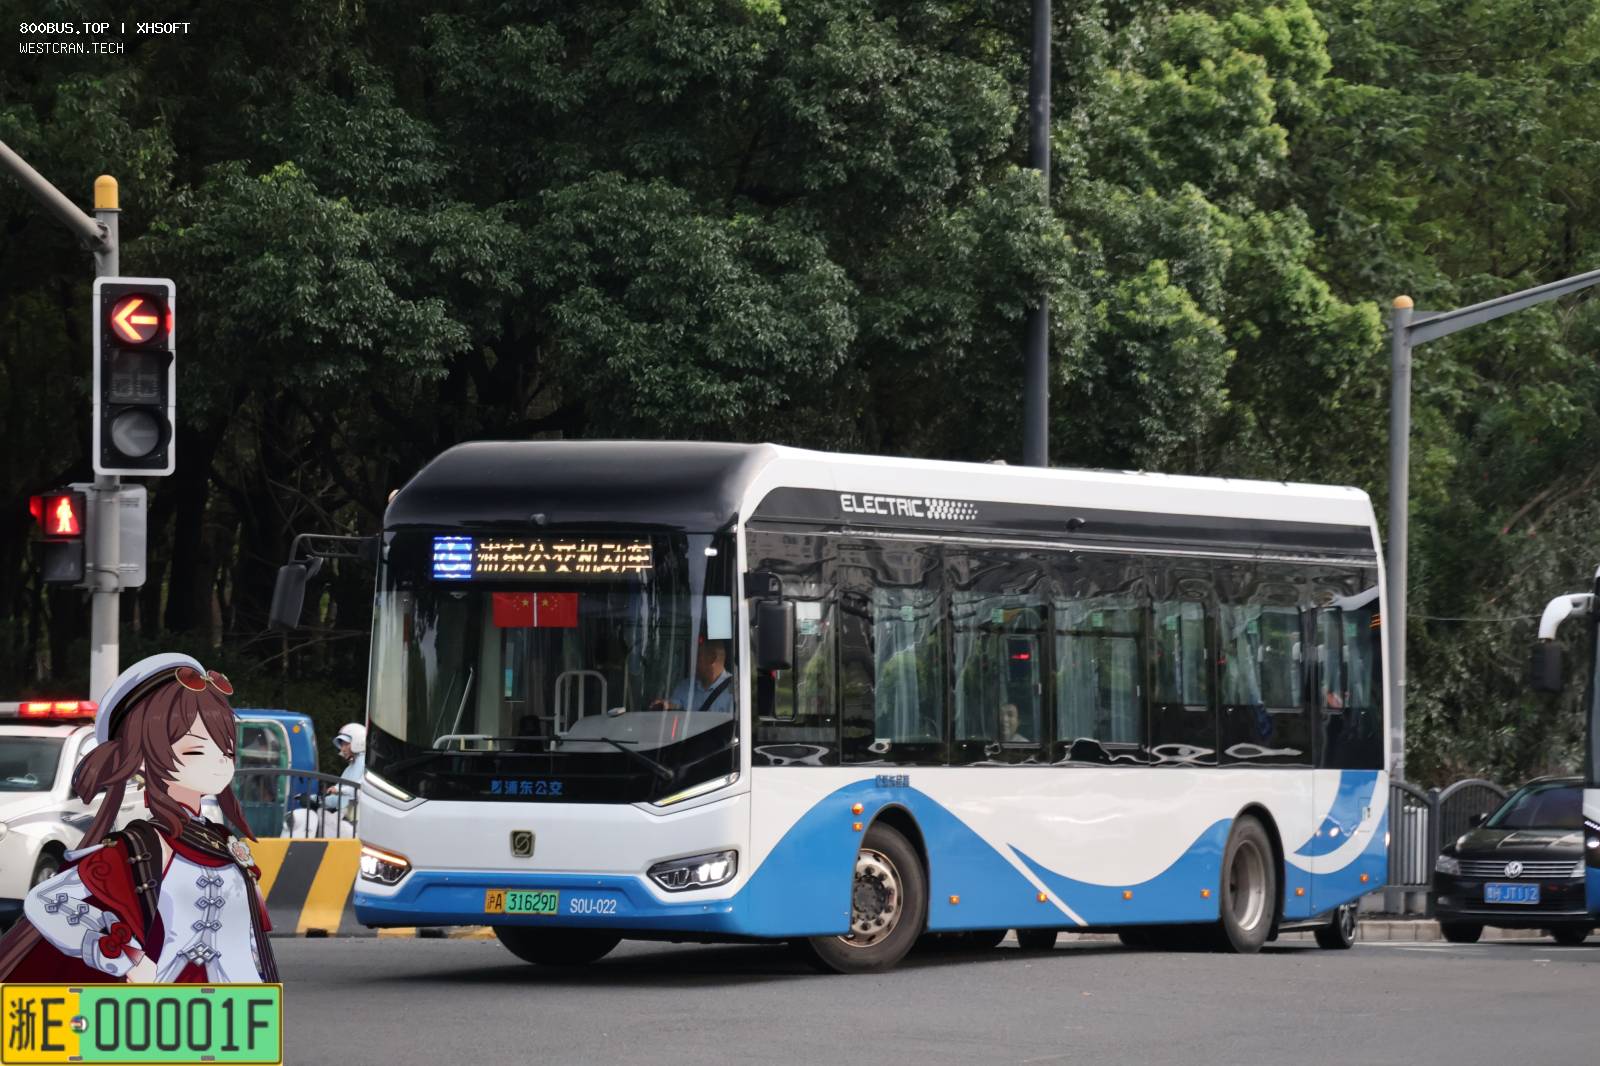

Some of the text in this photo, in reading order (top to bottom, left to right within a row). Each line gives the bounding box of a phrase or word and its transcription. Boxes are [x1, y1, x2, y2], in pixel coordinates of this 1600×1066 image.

[840, 494, 924, 517] ELECTRIC
[504, 781, 562, 795] 浦东公交
[509, 894, 556, 911] 31629D
